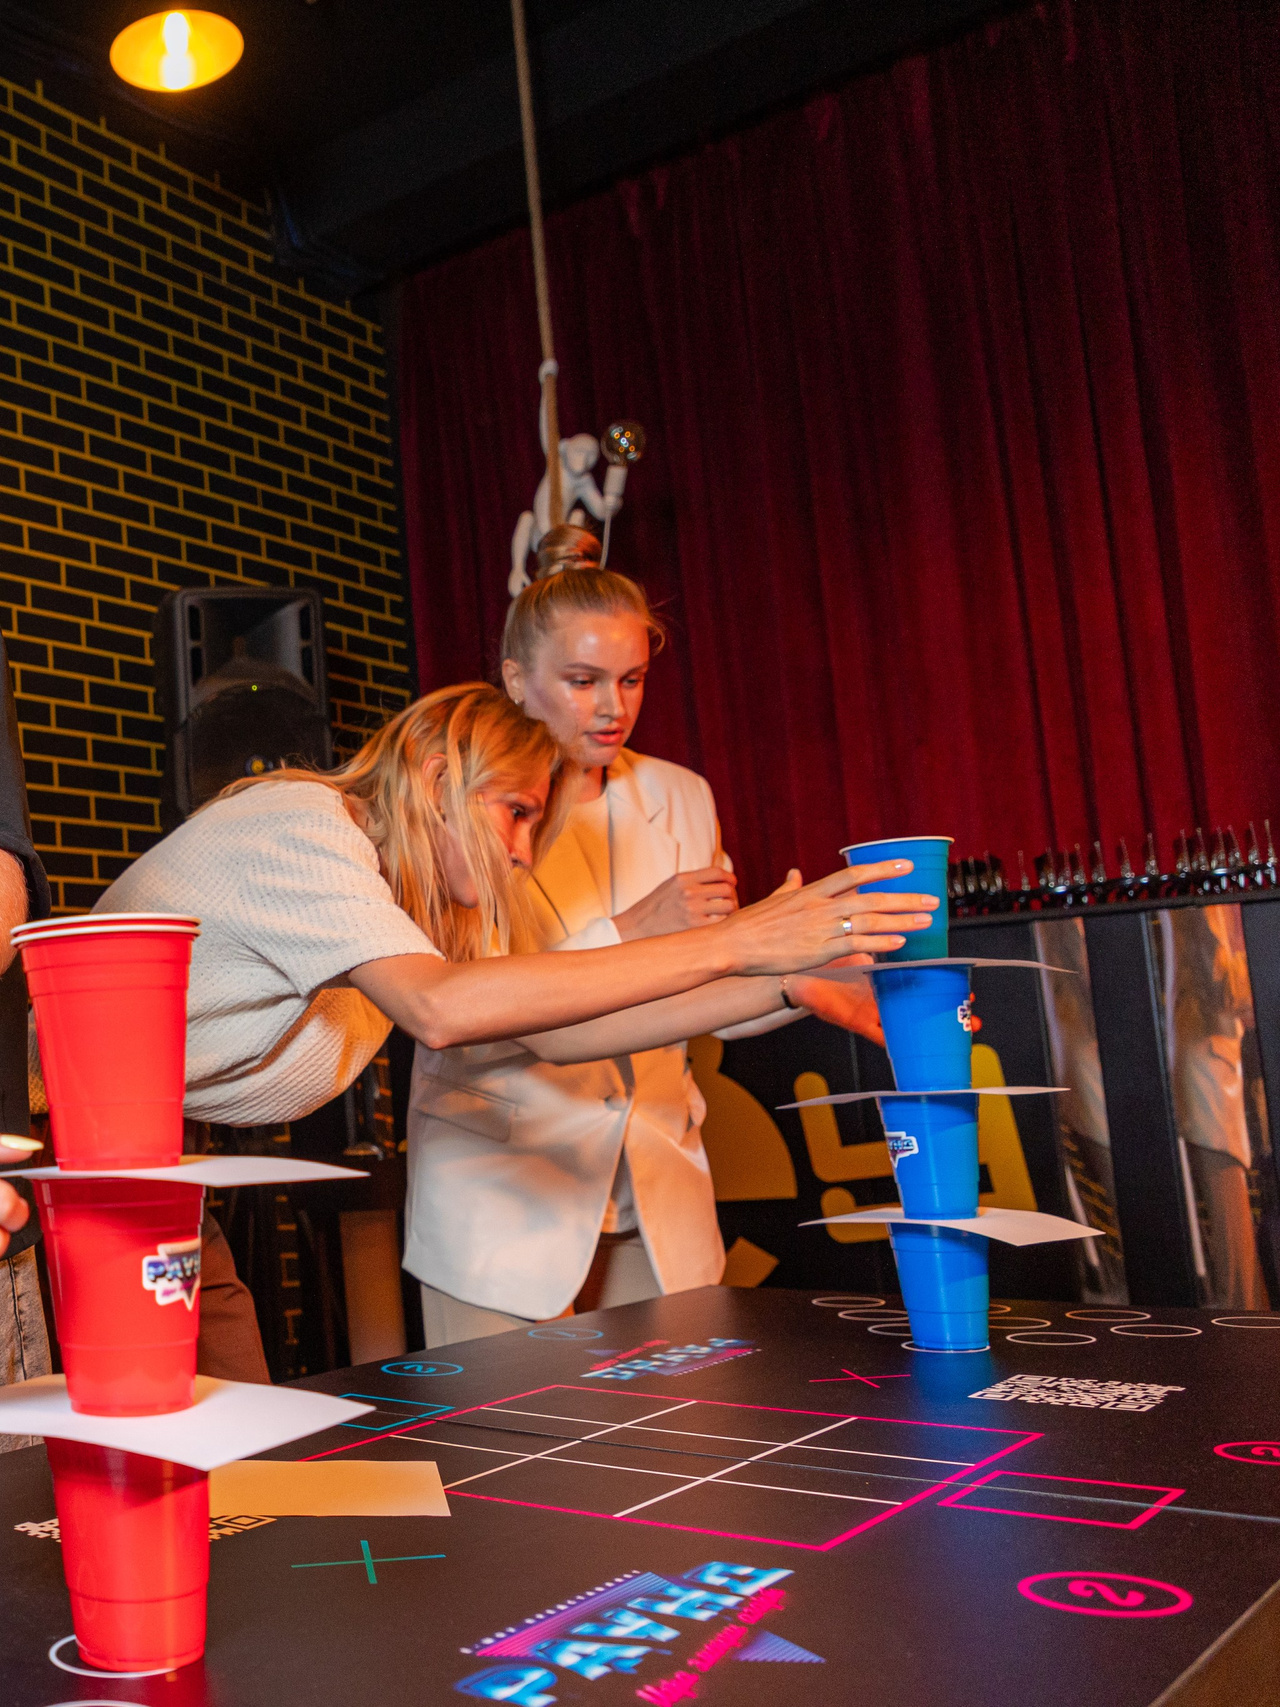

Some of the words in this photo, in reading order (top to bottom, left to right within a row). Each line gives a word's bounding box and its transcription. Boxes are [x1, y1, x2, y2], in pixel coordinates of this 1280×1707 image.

[403, 1364, 437, 1374] 2
[1068, 1580, 1146, 1607] 2
[454, 1561, 795, 1707] РАУНД
